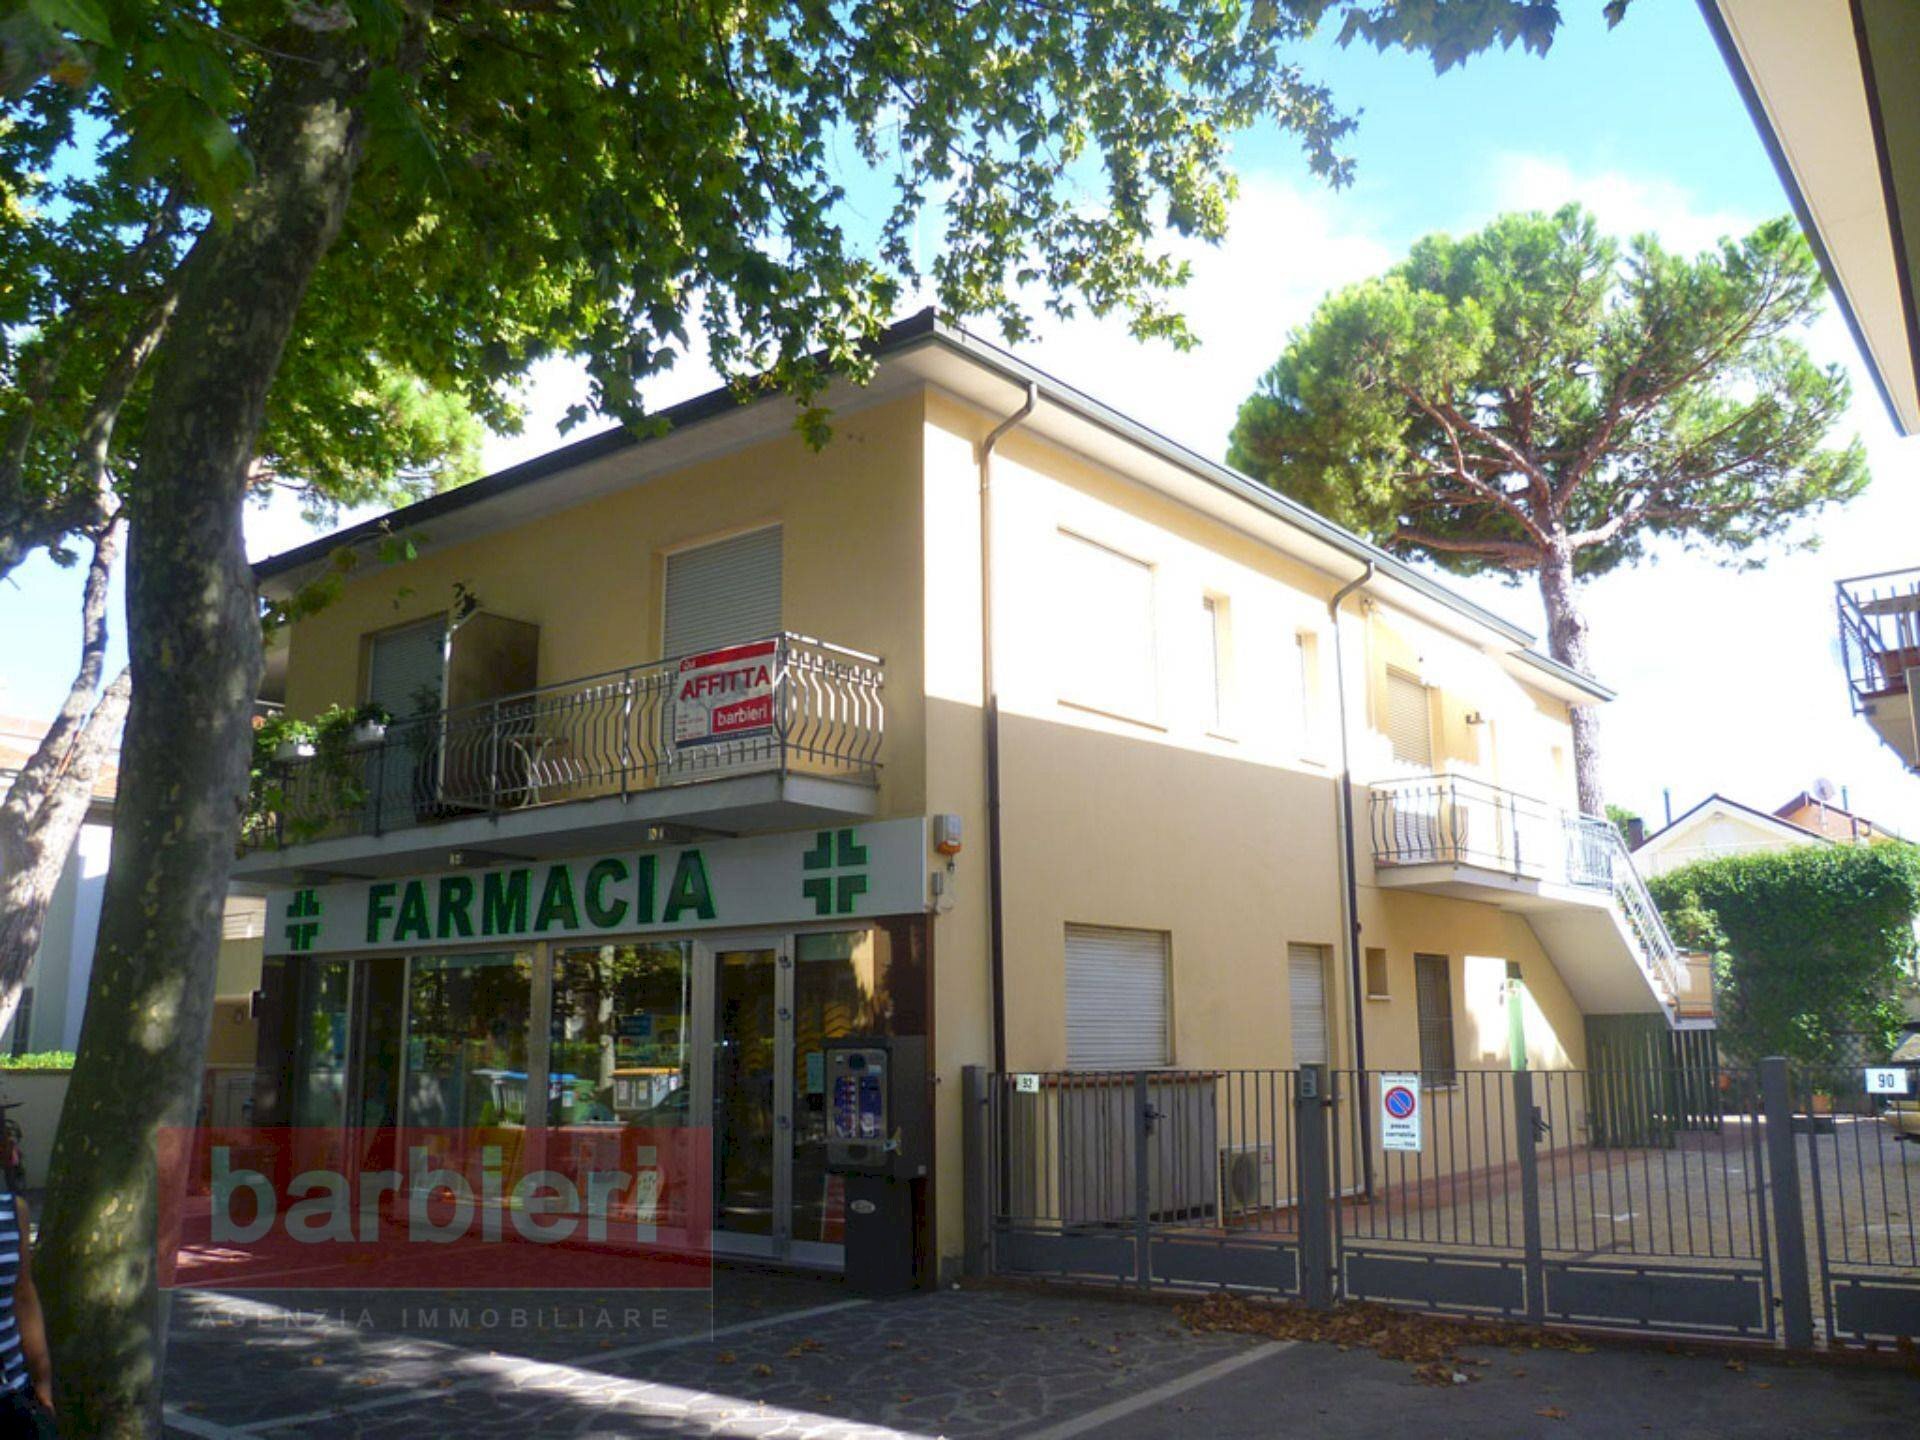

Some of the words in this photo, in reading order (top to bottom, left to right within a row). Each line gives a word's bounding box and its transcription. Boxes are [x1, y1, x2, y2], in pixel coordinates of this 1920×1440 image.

[680, 665, 770, 701] AFFITTA
[718, 704, 767, 727] barbieri
[366, 849, 717, 944] FARMACIA
[1878, 1073, 1895, 1088] 90
